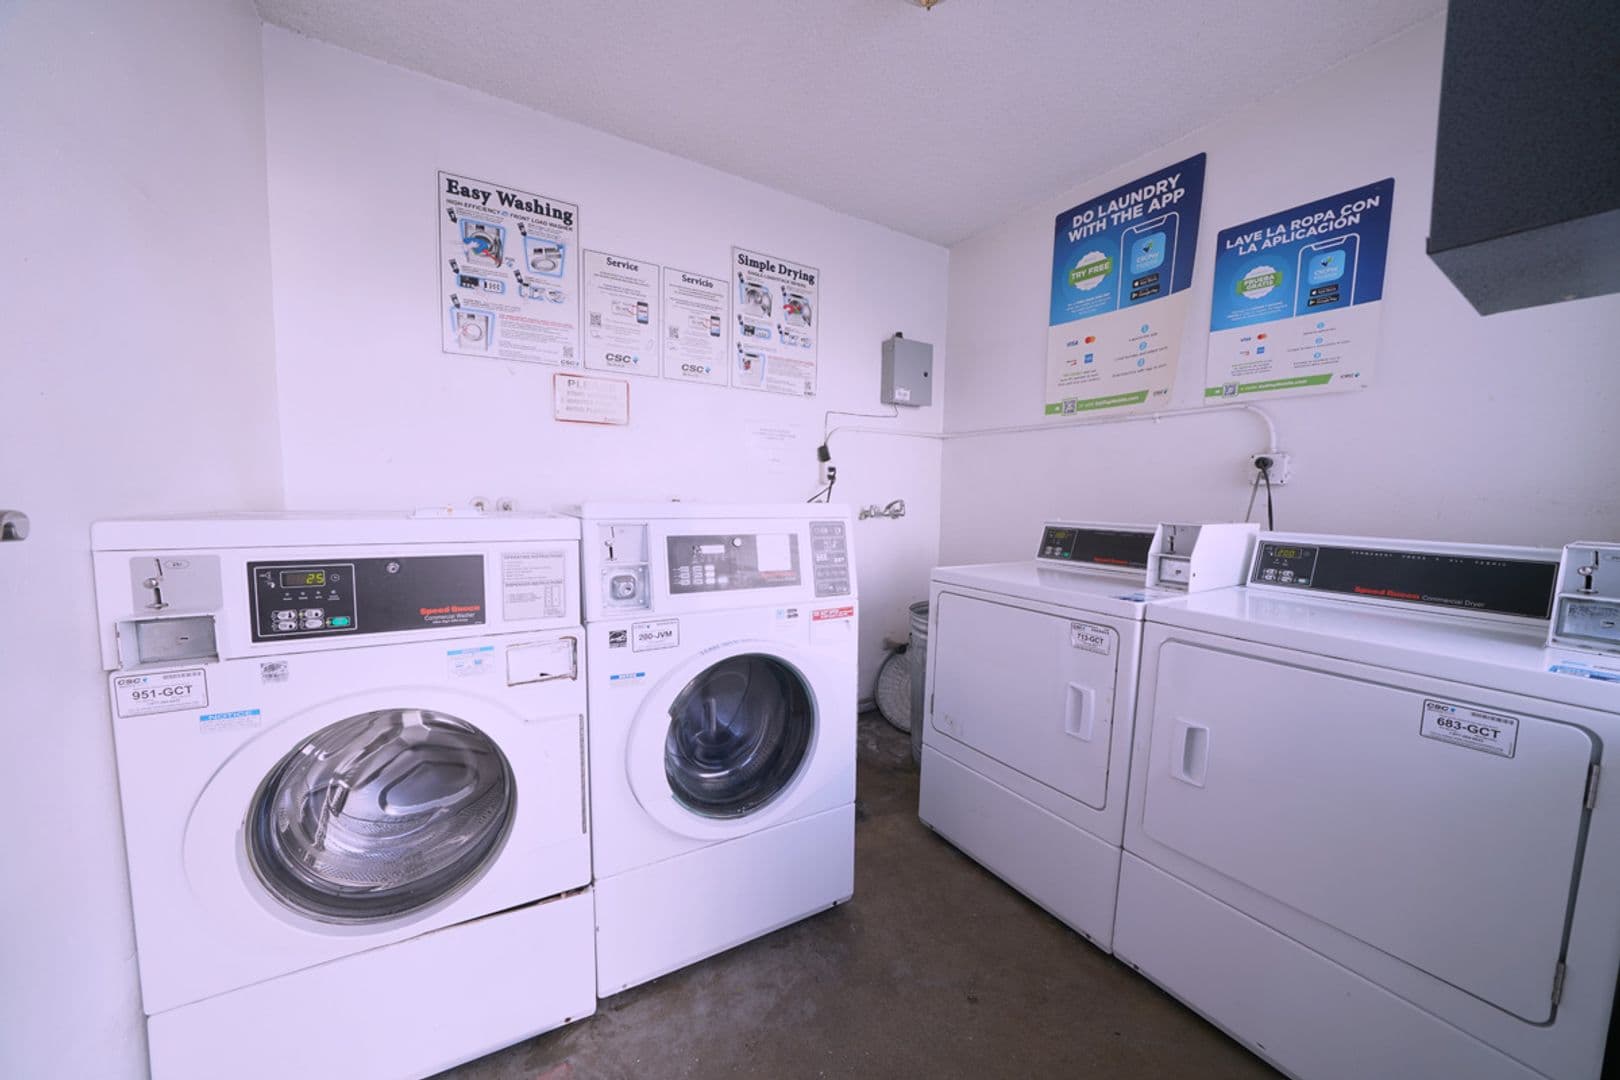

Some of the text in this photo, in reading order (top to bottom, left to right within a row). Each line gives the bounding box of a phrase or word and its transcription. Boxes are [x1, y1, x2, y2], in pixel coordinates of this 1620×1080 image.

[446, 178, 492, 206] Easy
[496, 190, 573, 225] Washing
[1072, 173, 1182, 228] DO LAUNDRY
[463, 202, 500, 215] EFFICIENCY
[510, 212, 531, 222] FRONT
[1068, 187, 1185, 243] WITH THE APP
[1226, 195, 1381, 250] LAVE LA ROPA CON
[1238, 243, 1257, 256] LA
[606, 257, 639, 272] Service
[737, 253, 776, 273] Simple
[778, 263, 816, 286] Drying
[1071, 261, 1110, 280] TRY FREE
[681, 273, 715, 289] Servicio
[605, 352, 631, 363] CSC
[681, 363, 704, 374] CSC
[306, 573, 324, 585] 25
[132, 684, 193, 701] 951-GCT
[1436, 716, 1501, 739] 683-GCT
